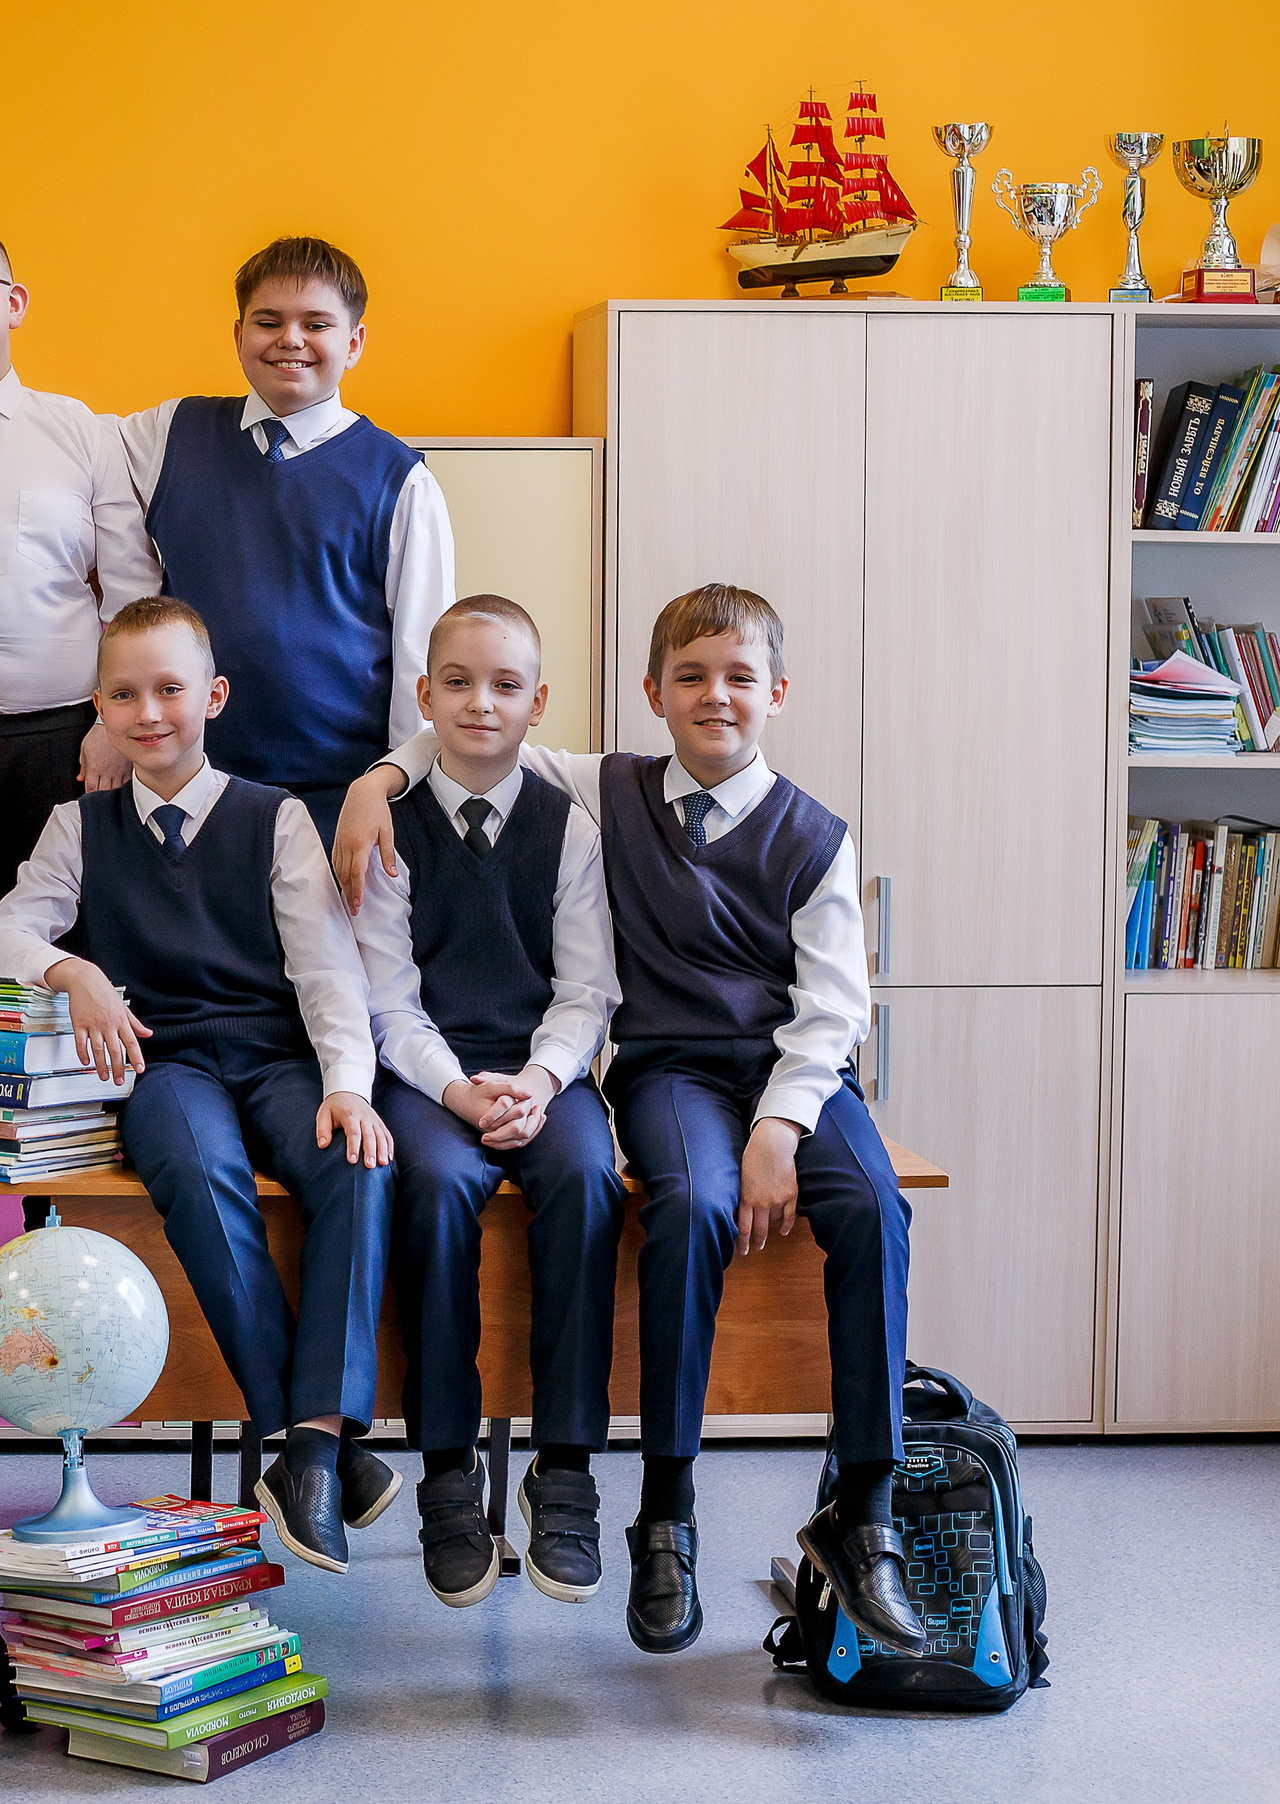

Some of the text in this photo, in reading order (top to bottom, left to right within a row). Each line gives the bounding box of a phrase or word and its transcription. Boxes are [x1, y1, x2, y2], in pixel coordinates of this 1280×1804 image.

[1193, 418, 1225, 496] ОД ВЕЙСЭНЬЛУВ
[1168, 457, 1188, 498] НОВЫЙ
[134, 1562, 167, 1581] MORDOVIA
[159, 1569, 200, 1587] ПОВЕДЕНИЯ
[165, 1578, 253, 1610] КРАСНАЯ КНИГА
[138, 1625, 162, 1635] ОСНОВЫ
[191, 1613, 210, 1622] ЭТИКИ
[927, 1617, 947, 1626] Super
[165, 1641, 187, 1650] ОСНОВЫ
[214, 1629, 232, 1638] ЭТИКИ
[859, 1644, 874, 1652] uper
[164, 1678, 193, 1696] БОЛЬШАЯ
[169, 1696, 199, 1712] БОЛЬШАЯ
[266, 1686, 317, 1711] МОРДОВИЯ
[186, 1716, 229, 1739] MORDOVIA
[222, 1734, 269, 1765] С.И.ОЖЕГОВ
